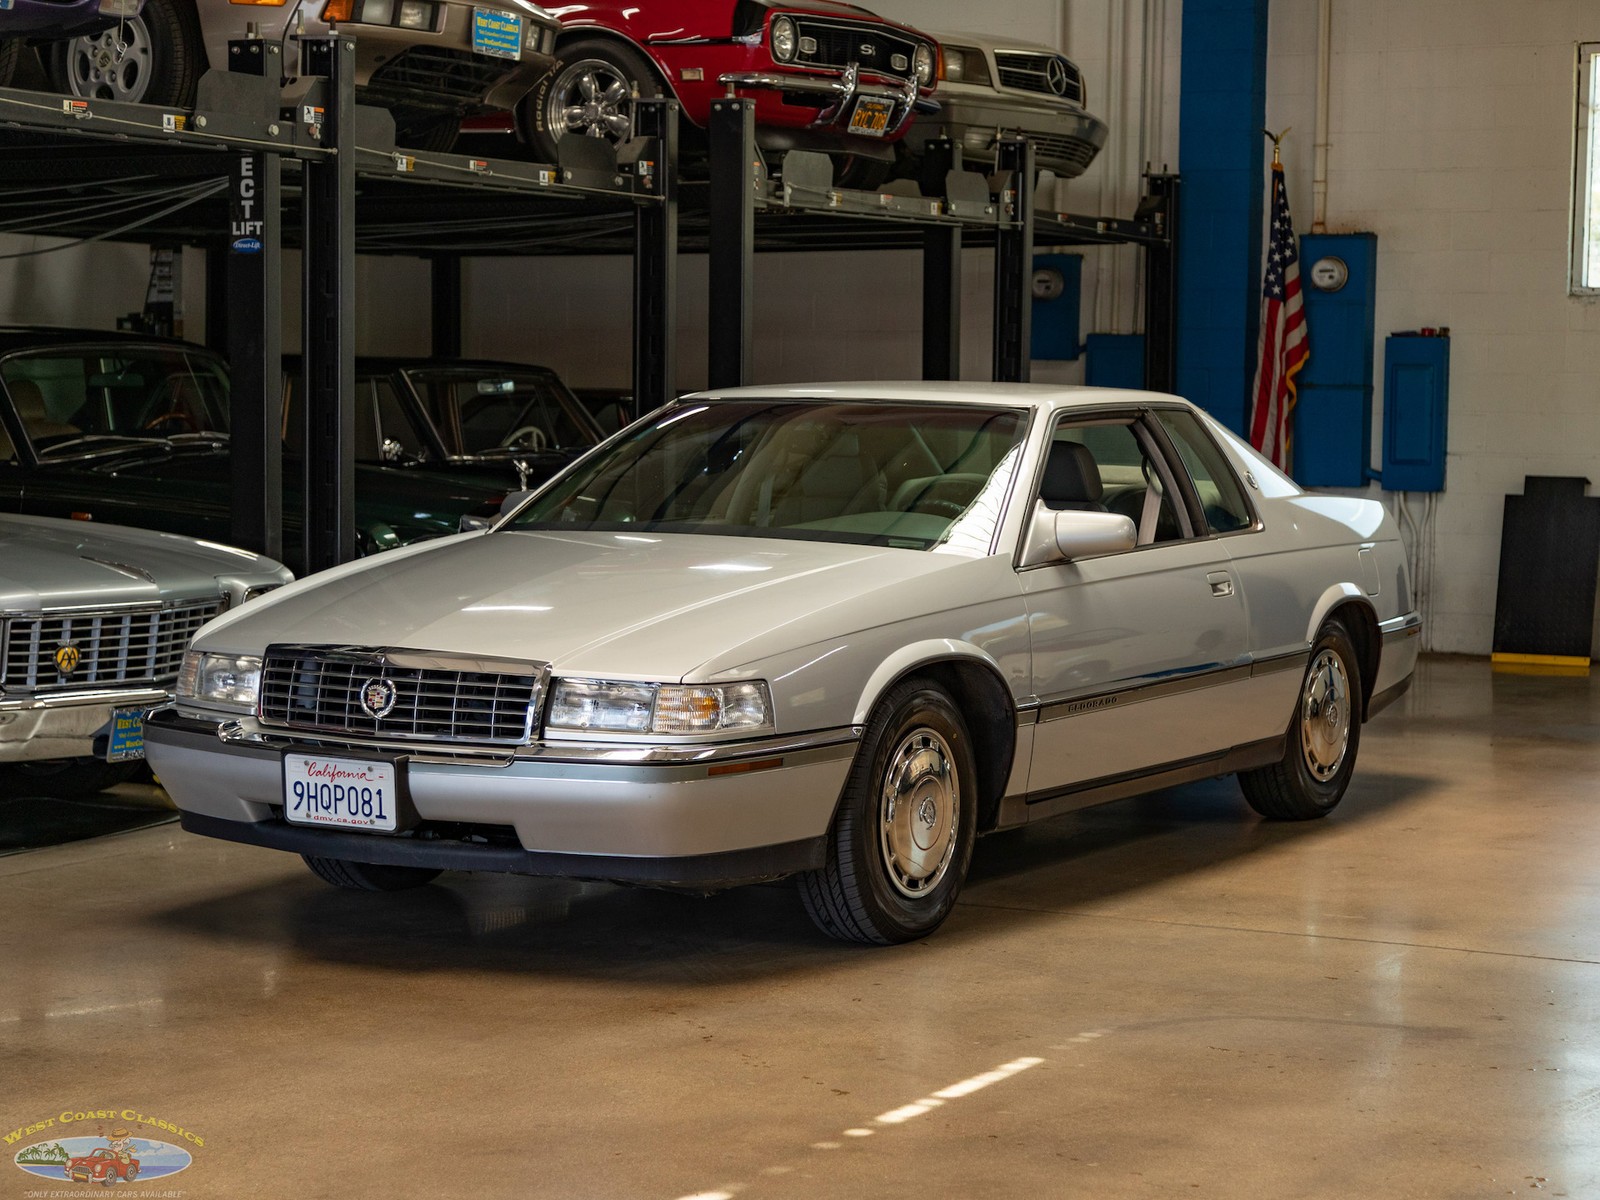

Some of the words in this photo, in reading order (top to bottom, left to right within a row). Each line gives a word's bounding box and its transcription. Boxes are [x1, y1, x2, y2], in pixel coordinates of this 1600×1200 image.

[852, 109, 872, 128] RYC
[240, 157, 255, 219] ECT
[232, 221, 263, 236] LIFT
[233, 241, 261, 249] Direct-Lift
[1068, 696, 1117, 712] ELDORADO
[307, 761, 374, 783] California
[293, 780, 387, 820] 9HQP081
[313, 814, 369, 825] dmv.ca.gov
